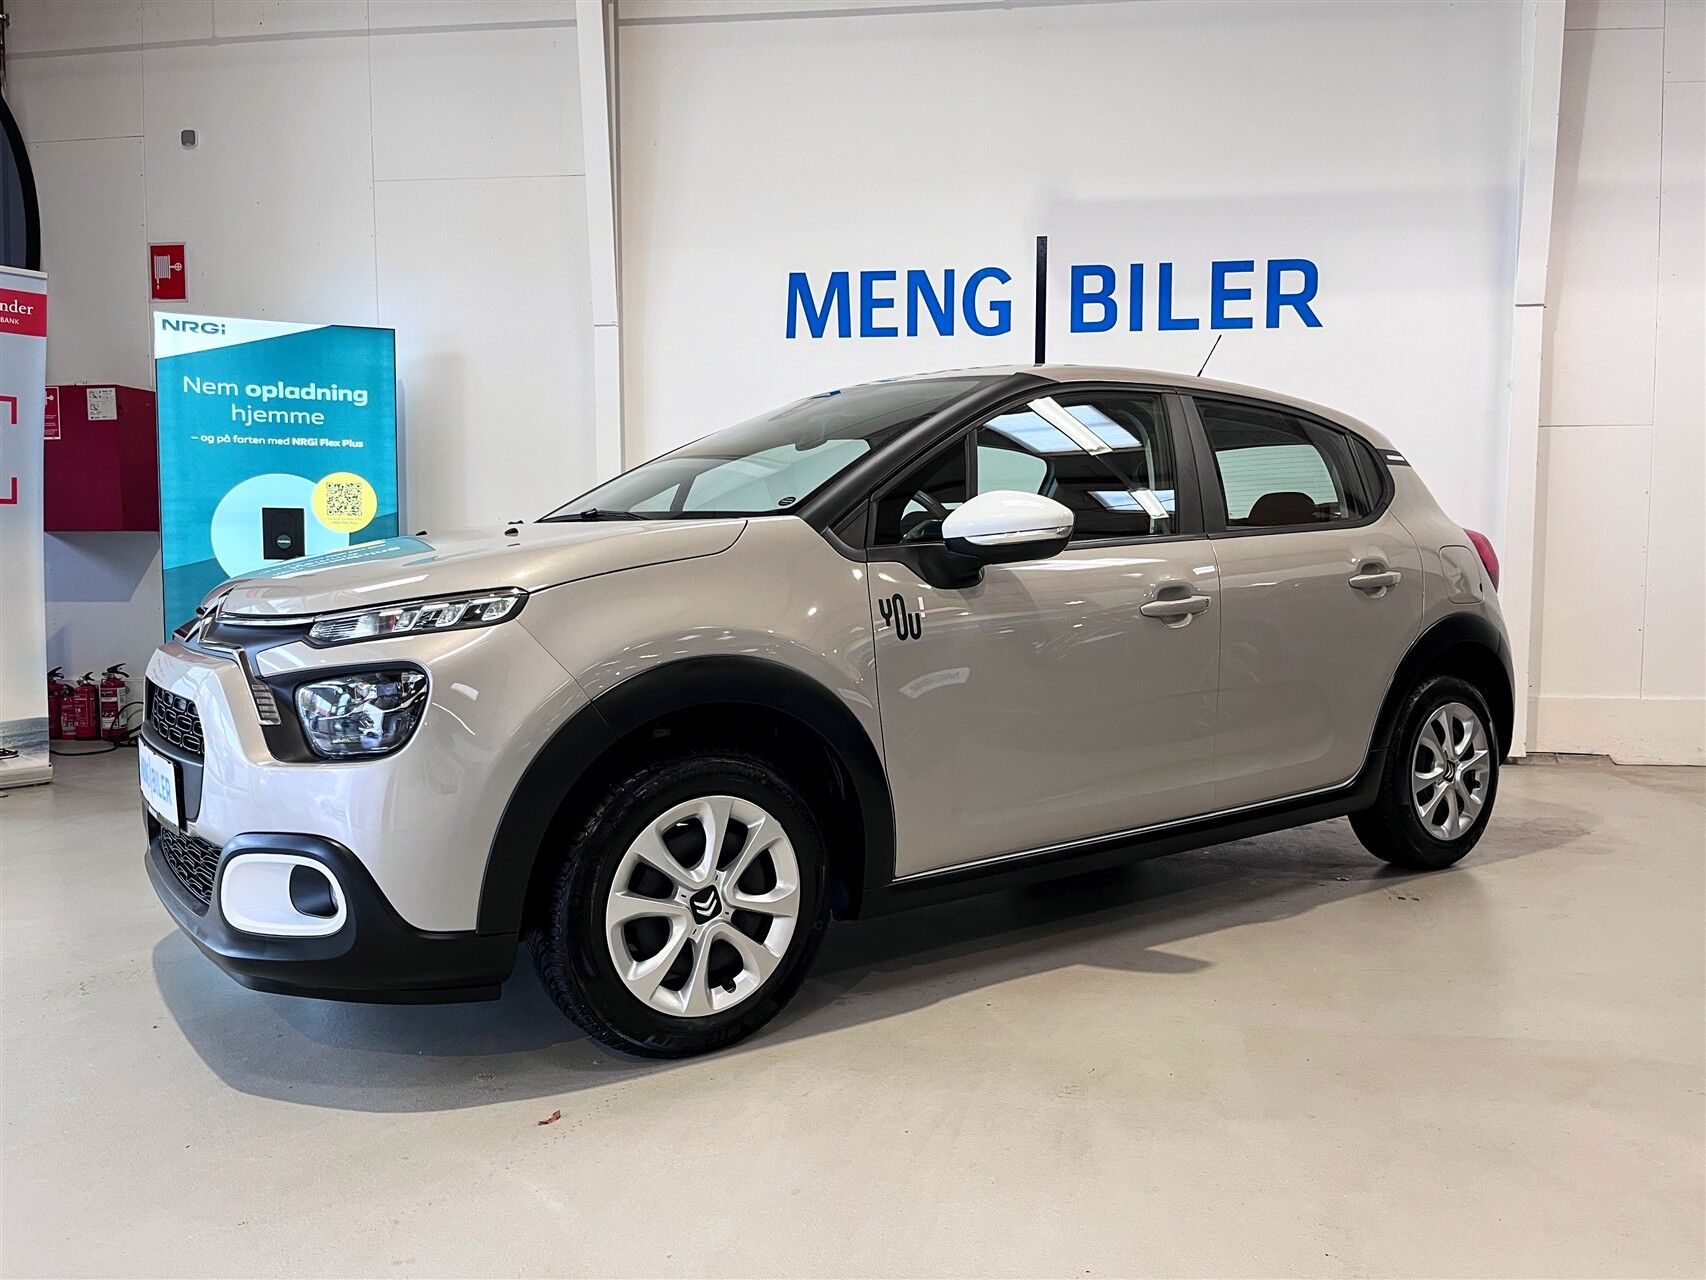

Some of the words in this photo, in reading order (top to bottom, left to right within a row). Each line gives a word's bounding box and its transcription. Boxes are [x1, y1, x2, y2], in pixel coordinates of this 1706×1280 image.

[785, 266, 1012, 339] MENG
[1070, 258, 1324, 334] BILER
[0, 317, 20, 325] BANK
[162, 318, 226, 335] NRGi
[183, 375, 238, 396] Nem
[245, 381, 368, 407] opladning
[231, 403, 325, 427] hjemme
[200, 434, 214, 444] og
[217, 433, 231, 445] på
[233, 434, 265, 445] farten
[268, 436, 290, 446] med
[292, 437, 318, 446] NRGi
[319, 438, 341, 447] Flex
[342, 438, 364, 448] Plus
